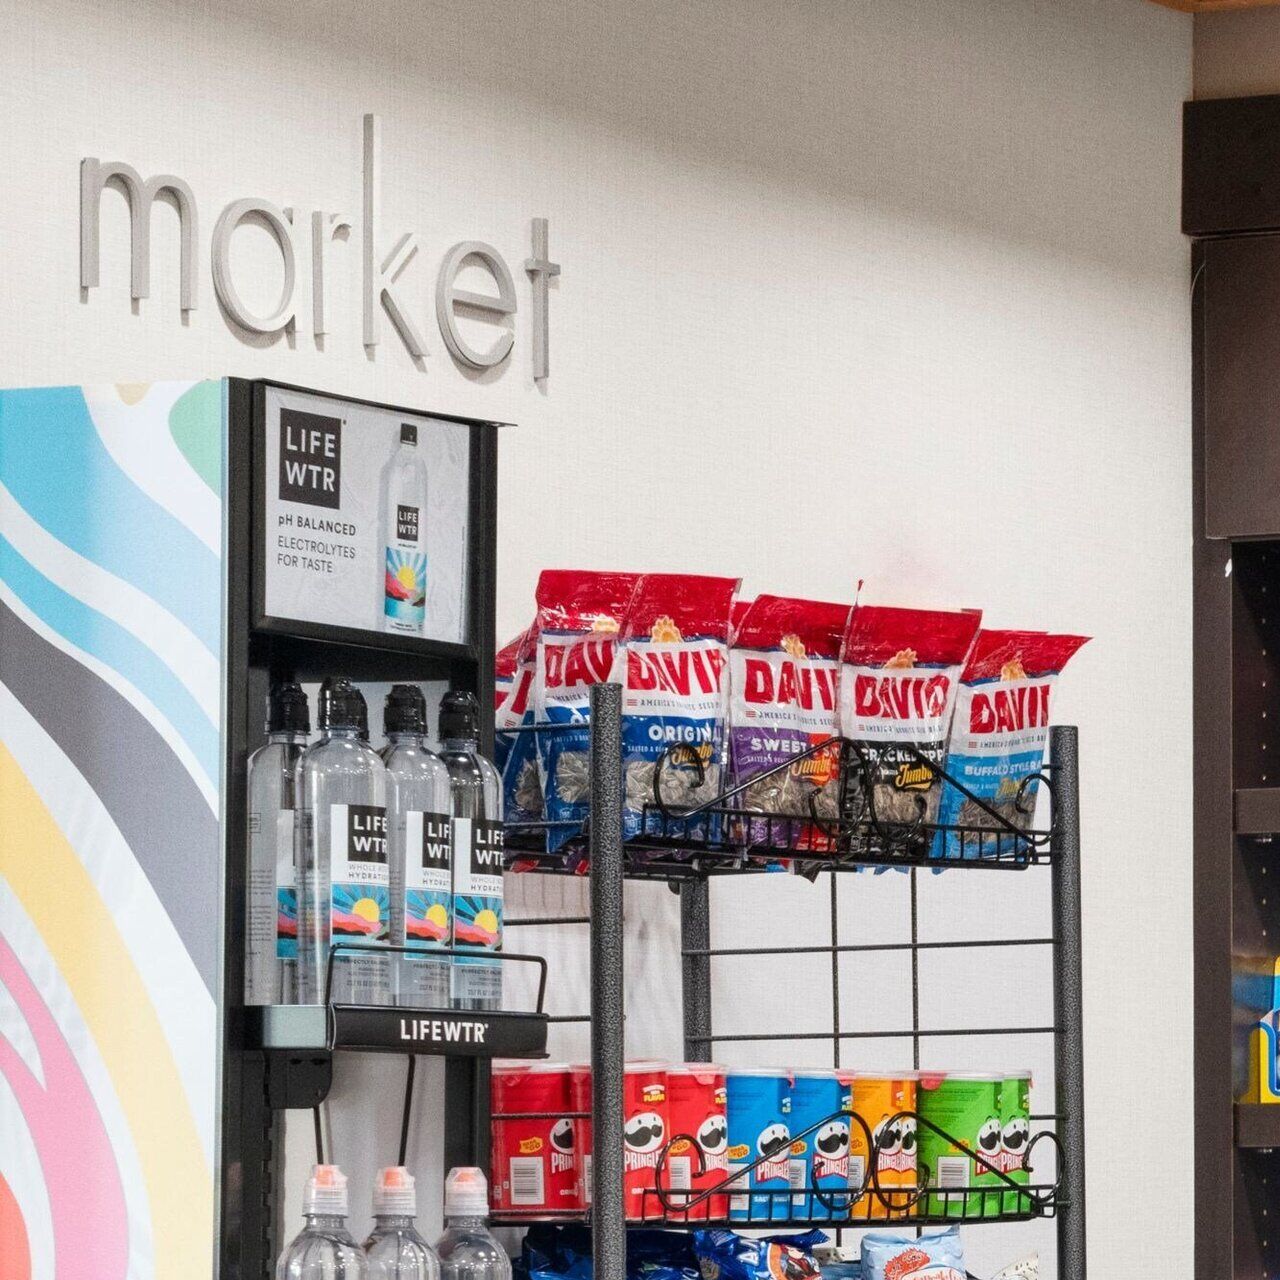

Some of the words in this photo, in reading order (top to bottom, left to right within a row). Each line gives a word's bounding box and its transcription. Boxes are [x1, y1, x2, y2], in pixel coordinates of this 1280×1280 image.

[80, 114, 561, 381] market
[286, 426, 336, 458] LIFE
[285, 460, 335, 492] WTR
[278, 515, 293, 528] pH
[296, 516, 357, 537] BALANCED
[398, 510, 418, 523] LIFE
[398, 523, 418, 536] WTR
[277, 535, 356, 559] ELECTROLYTES
[277, 553, 299, 569] FOR
[302, 557, 333, 574] TASTE
[400, 1019, 488, 1043] LIFEWTR
